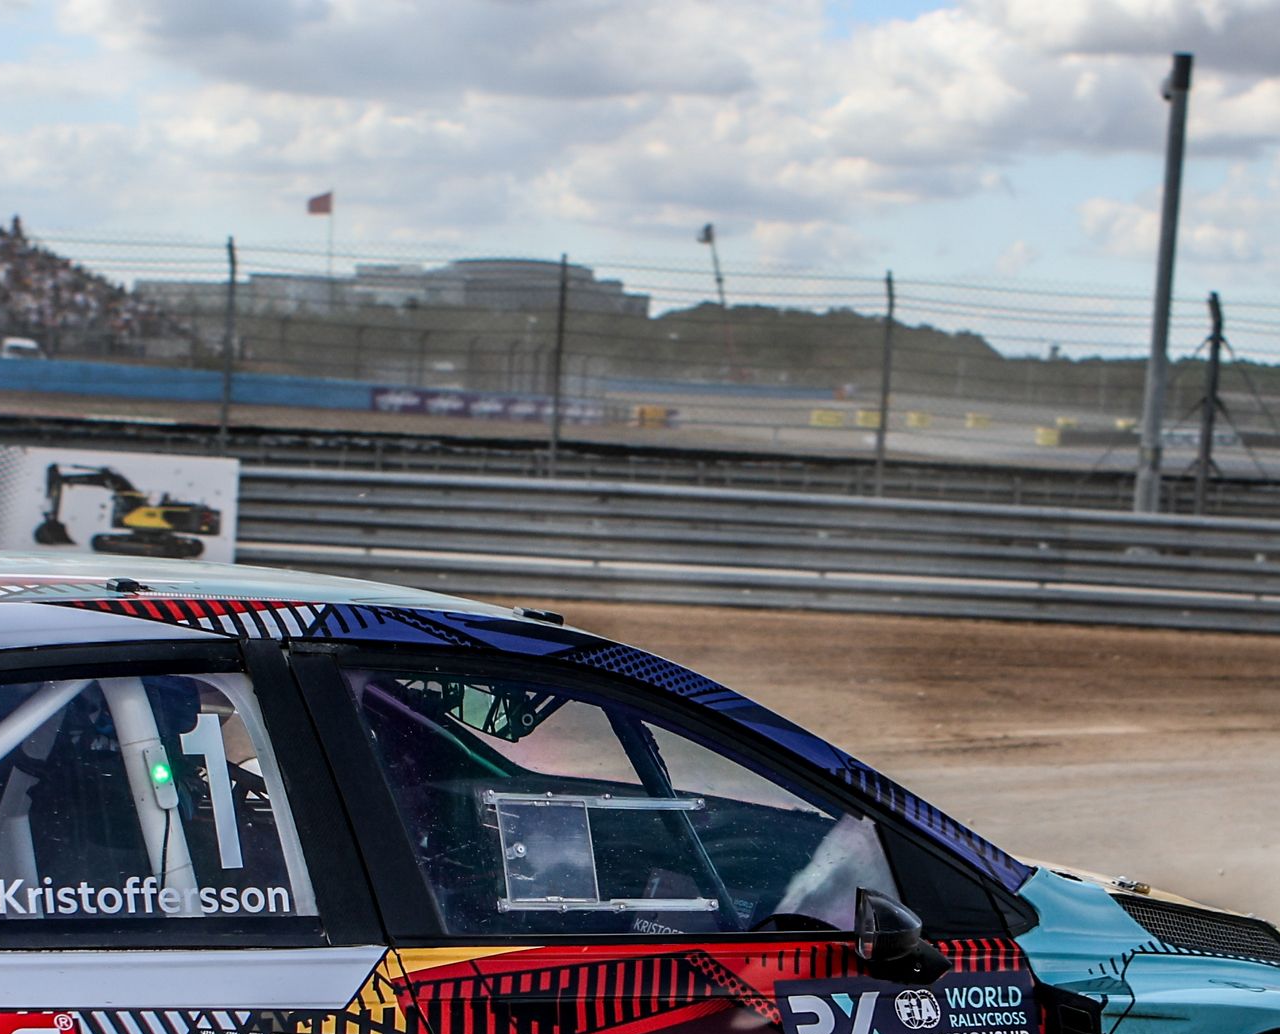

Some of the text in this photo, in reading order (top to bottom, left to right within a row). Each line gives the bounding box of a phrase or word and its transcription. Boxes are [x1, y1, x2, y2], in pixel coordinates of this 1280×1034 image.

[180, 713, 244, 870] 1
[945, 986, 1021, 1009] WORLD
[949, 1011, 1027, 1028] RALLYCROSS
